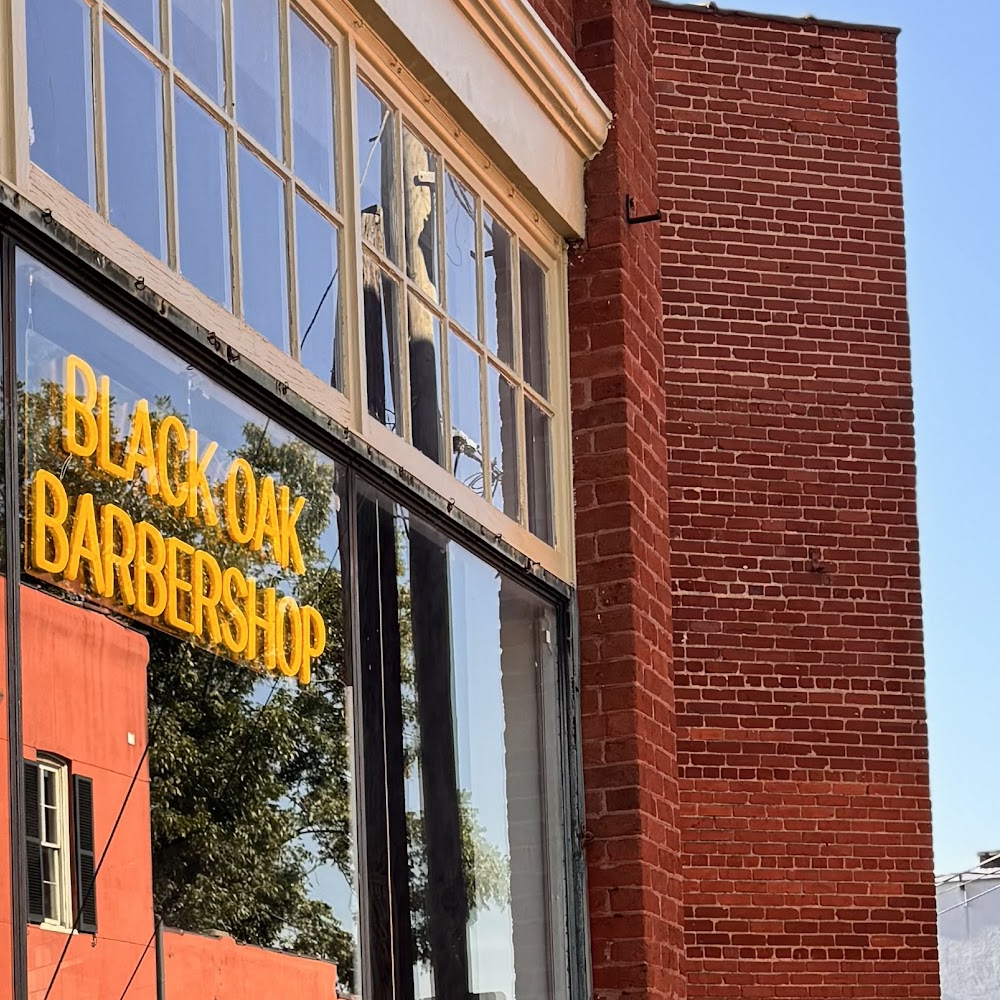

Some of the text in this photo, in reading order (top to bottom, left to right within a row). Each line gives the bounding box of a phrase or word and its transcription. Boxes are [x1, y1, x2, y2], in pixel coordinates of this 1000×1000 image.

[65, 354, 307, 577] BLACK OAK
[33, 468, 327, 685] BARBERSHOP
